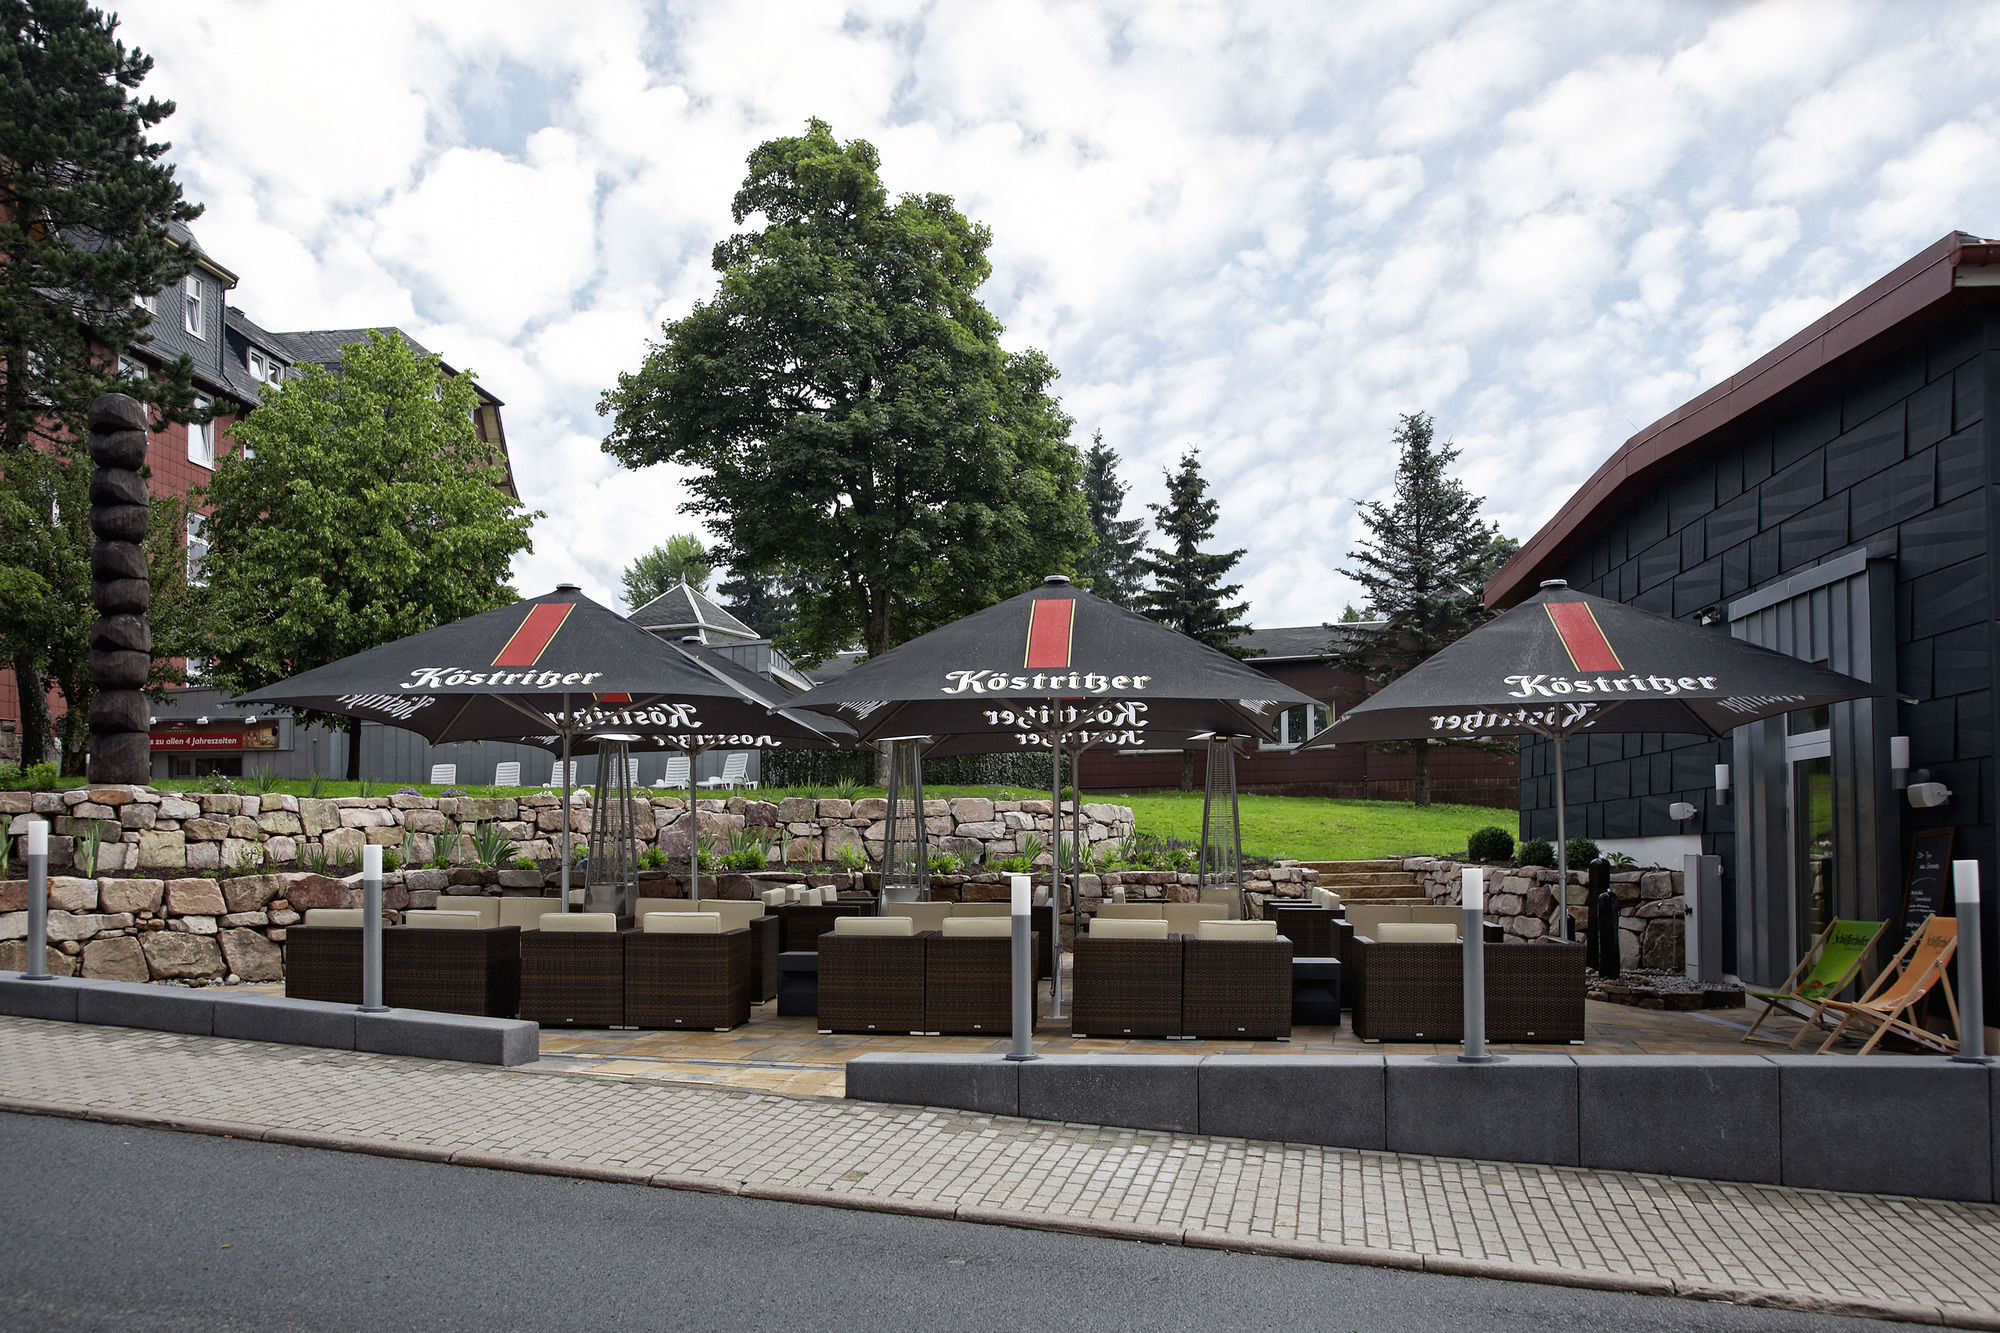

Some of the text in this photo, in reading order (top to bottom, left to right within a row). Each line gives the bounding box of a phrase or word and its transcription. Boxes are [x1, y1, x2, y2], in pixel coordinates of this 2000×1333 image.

[399, 667, 603, 689] Köstritzer
[941, 669, 1152, 694] Köstritzer
[1503, 673, 1717, 698] Köstritzer
[166, 737, 184, 745] allen
[185, 737, 191, 745] 4
[191, 737, 237, 746] Jahreszeiten
